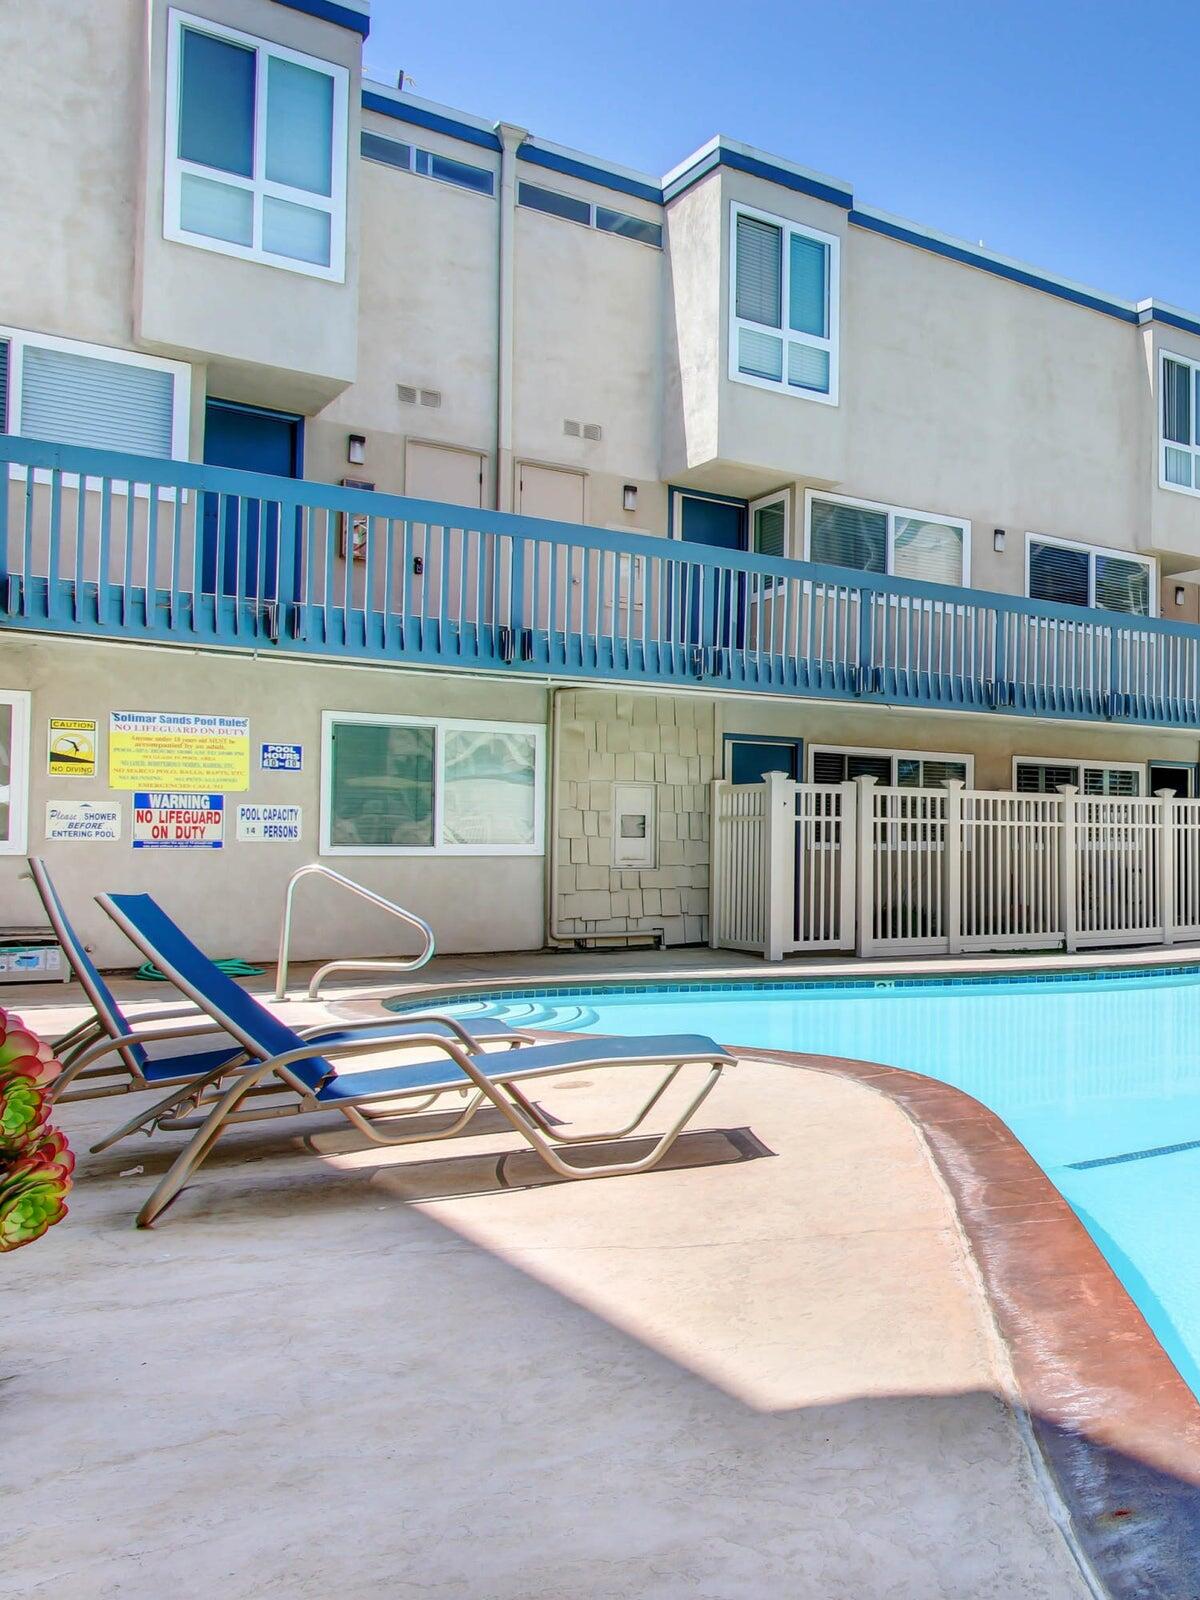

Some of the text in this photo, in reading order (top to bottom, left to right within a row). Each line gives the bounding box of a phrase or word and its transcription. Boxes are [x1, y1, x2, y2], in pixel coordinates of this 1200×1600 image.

[113, 713, 247, 728] Solimar Sands Pool Rules
[115, 724, 131, 732] NO
[134, 724, 197, 734] LIFEGUARD
[218, 728, 245, 736] DUTY
[149, 794, 210, 809] WARNING
[50, 809, 117, 820] Please SHOWER
[136, 810, 221, 824] NO LIFEGUARD
[241, 808, 299, 821] POOL CAPACITY
[52, 830, 93, 838] ENTERING
[152, 825, 206, 839] ON DUTY
[263, 825, 298, 838] PERSONS
